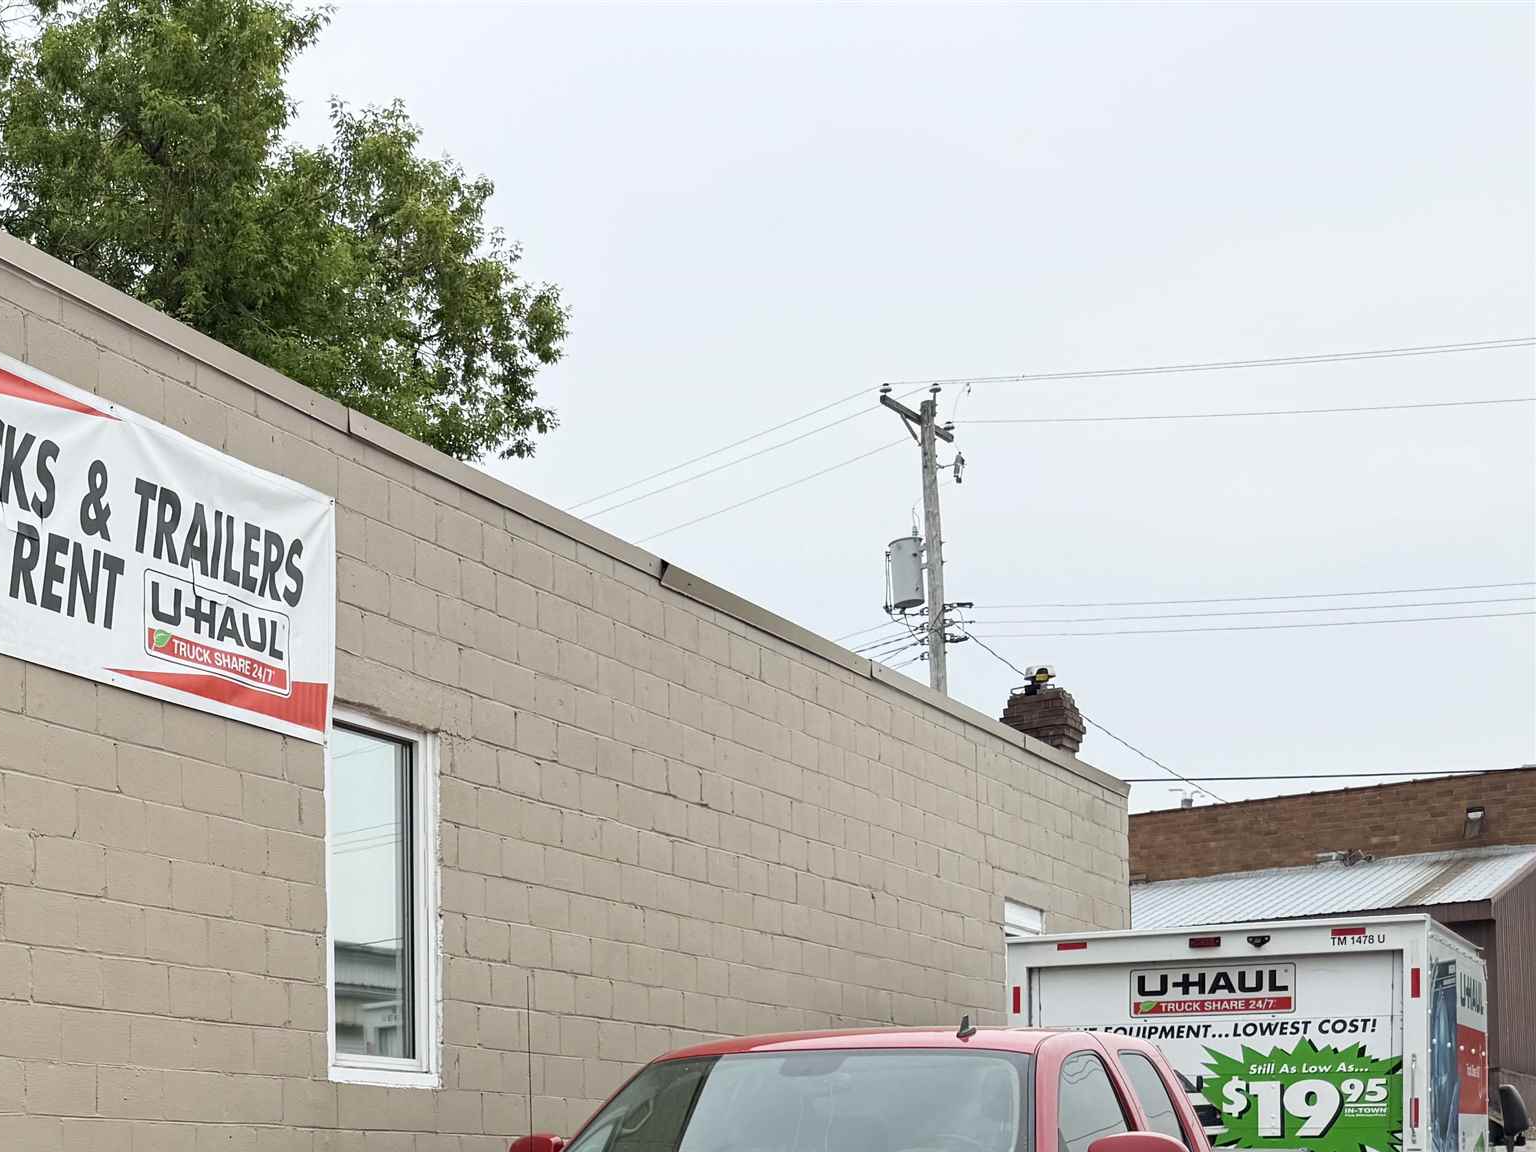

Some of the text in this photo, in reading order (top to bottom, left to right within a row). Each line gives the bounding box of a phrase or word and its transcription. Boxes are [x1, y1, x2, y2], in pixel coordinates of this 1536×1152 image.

[79, 458, 112, 542] &
[133, 477, 304, 608] TRAILERS
[8, 521, 125, 630] RENT
[151, 580, 285, 661] U-HAUL
[171, 638, 274, 683] TRUCK SHARE 24/7
[1330, 934, 1386, 946] TM 1478 U
[1137, 968, 1289, 998] U-HAUL
[1160, 997, 1274, 1013] TRUCK SHARE 24/7
[1232, 1020, 1312, 1037] LOWEST
[1318, 1018, 1377, 1035] COST!
[1249, 1061, 1370, 1075] Still As Low As...
